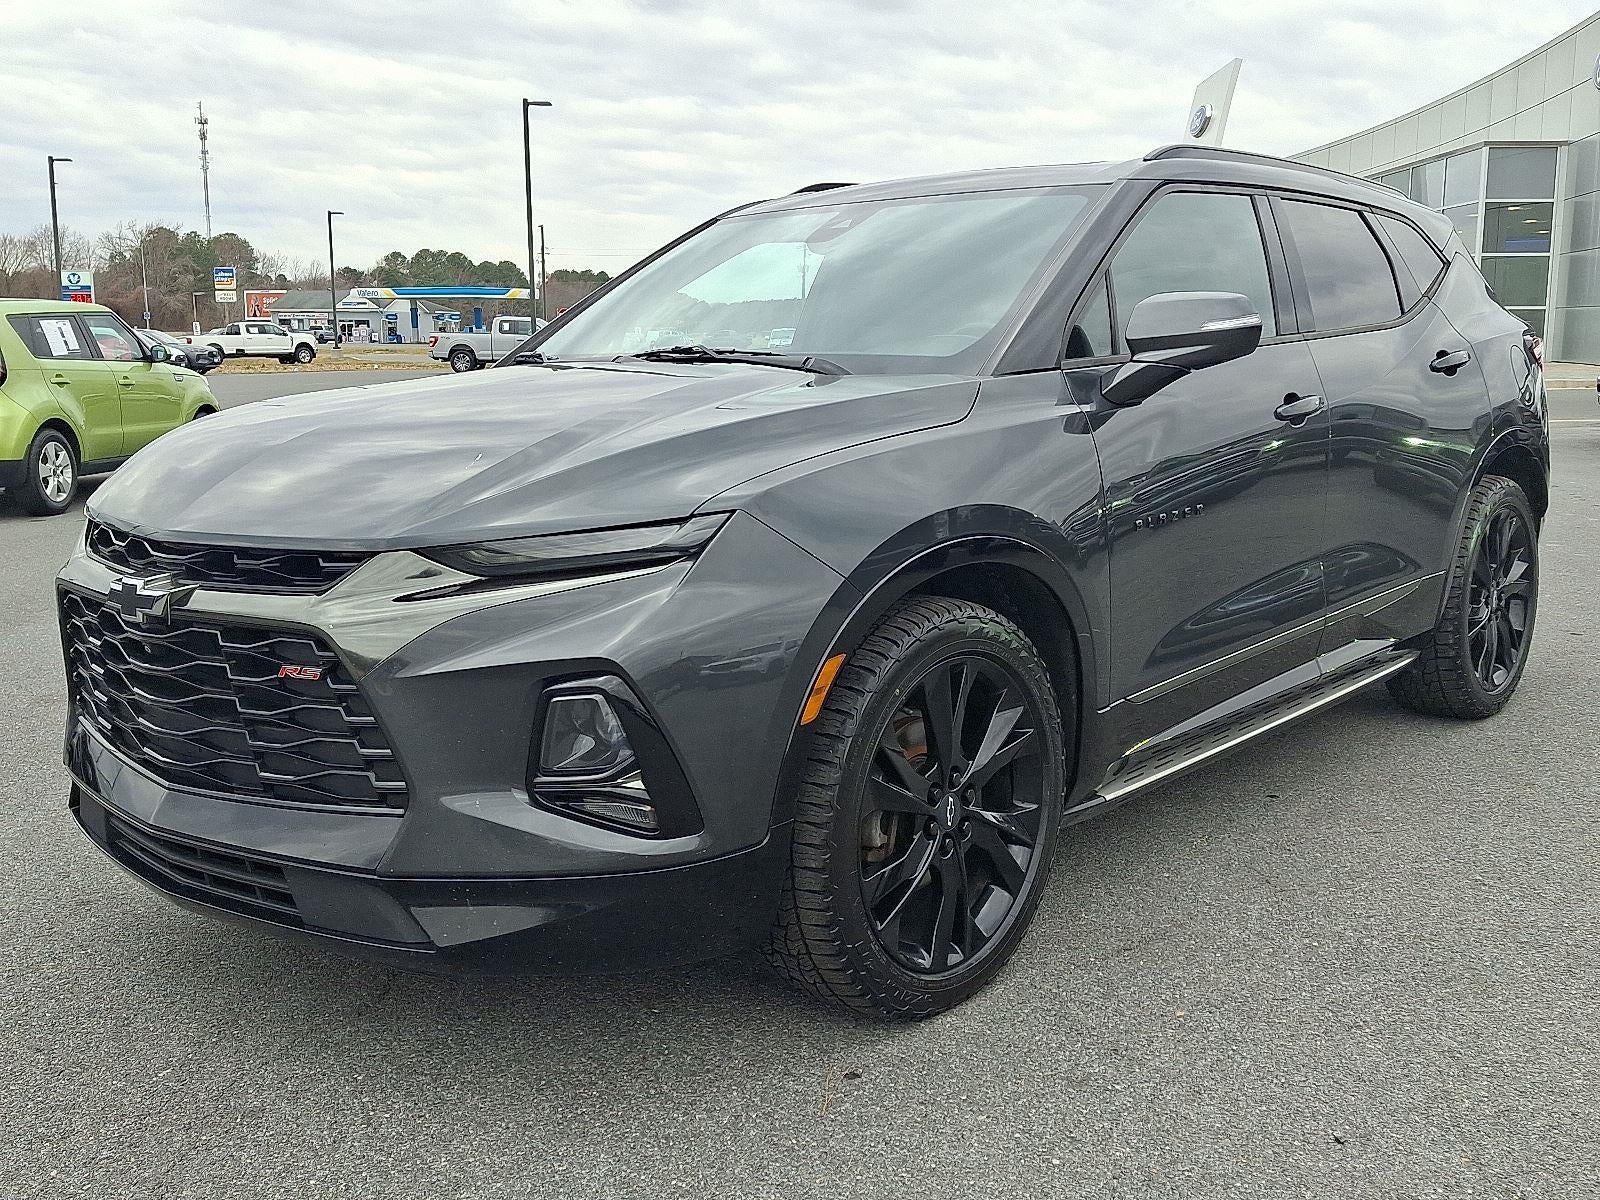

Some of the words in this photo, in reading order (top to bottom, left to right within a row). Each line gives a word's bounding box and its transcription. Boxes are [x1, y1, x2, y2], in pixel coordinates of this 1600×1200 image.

[356, 289, 379, 297] Valero
[1134, 503, 1205, 533] BLAZER
[278, 665, 322, 680] RS
